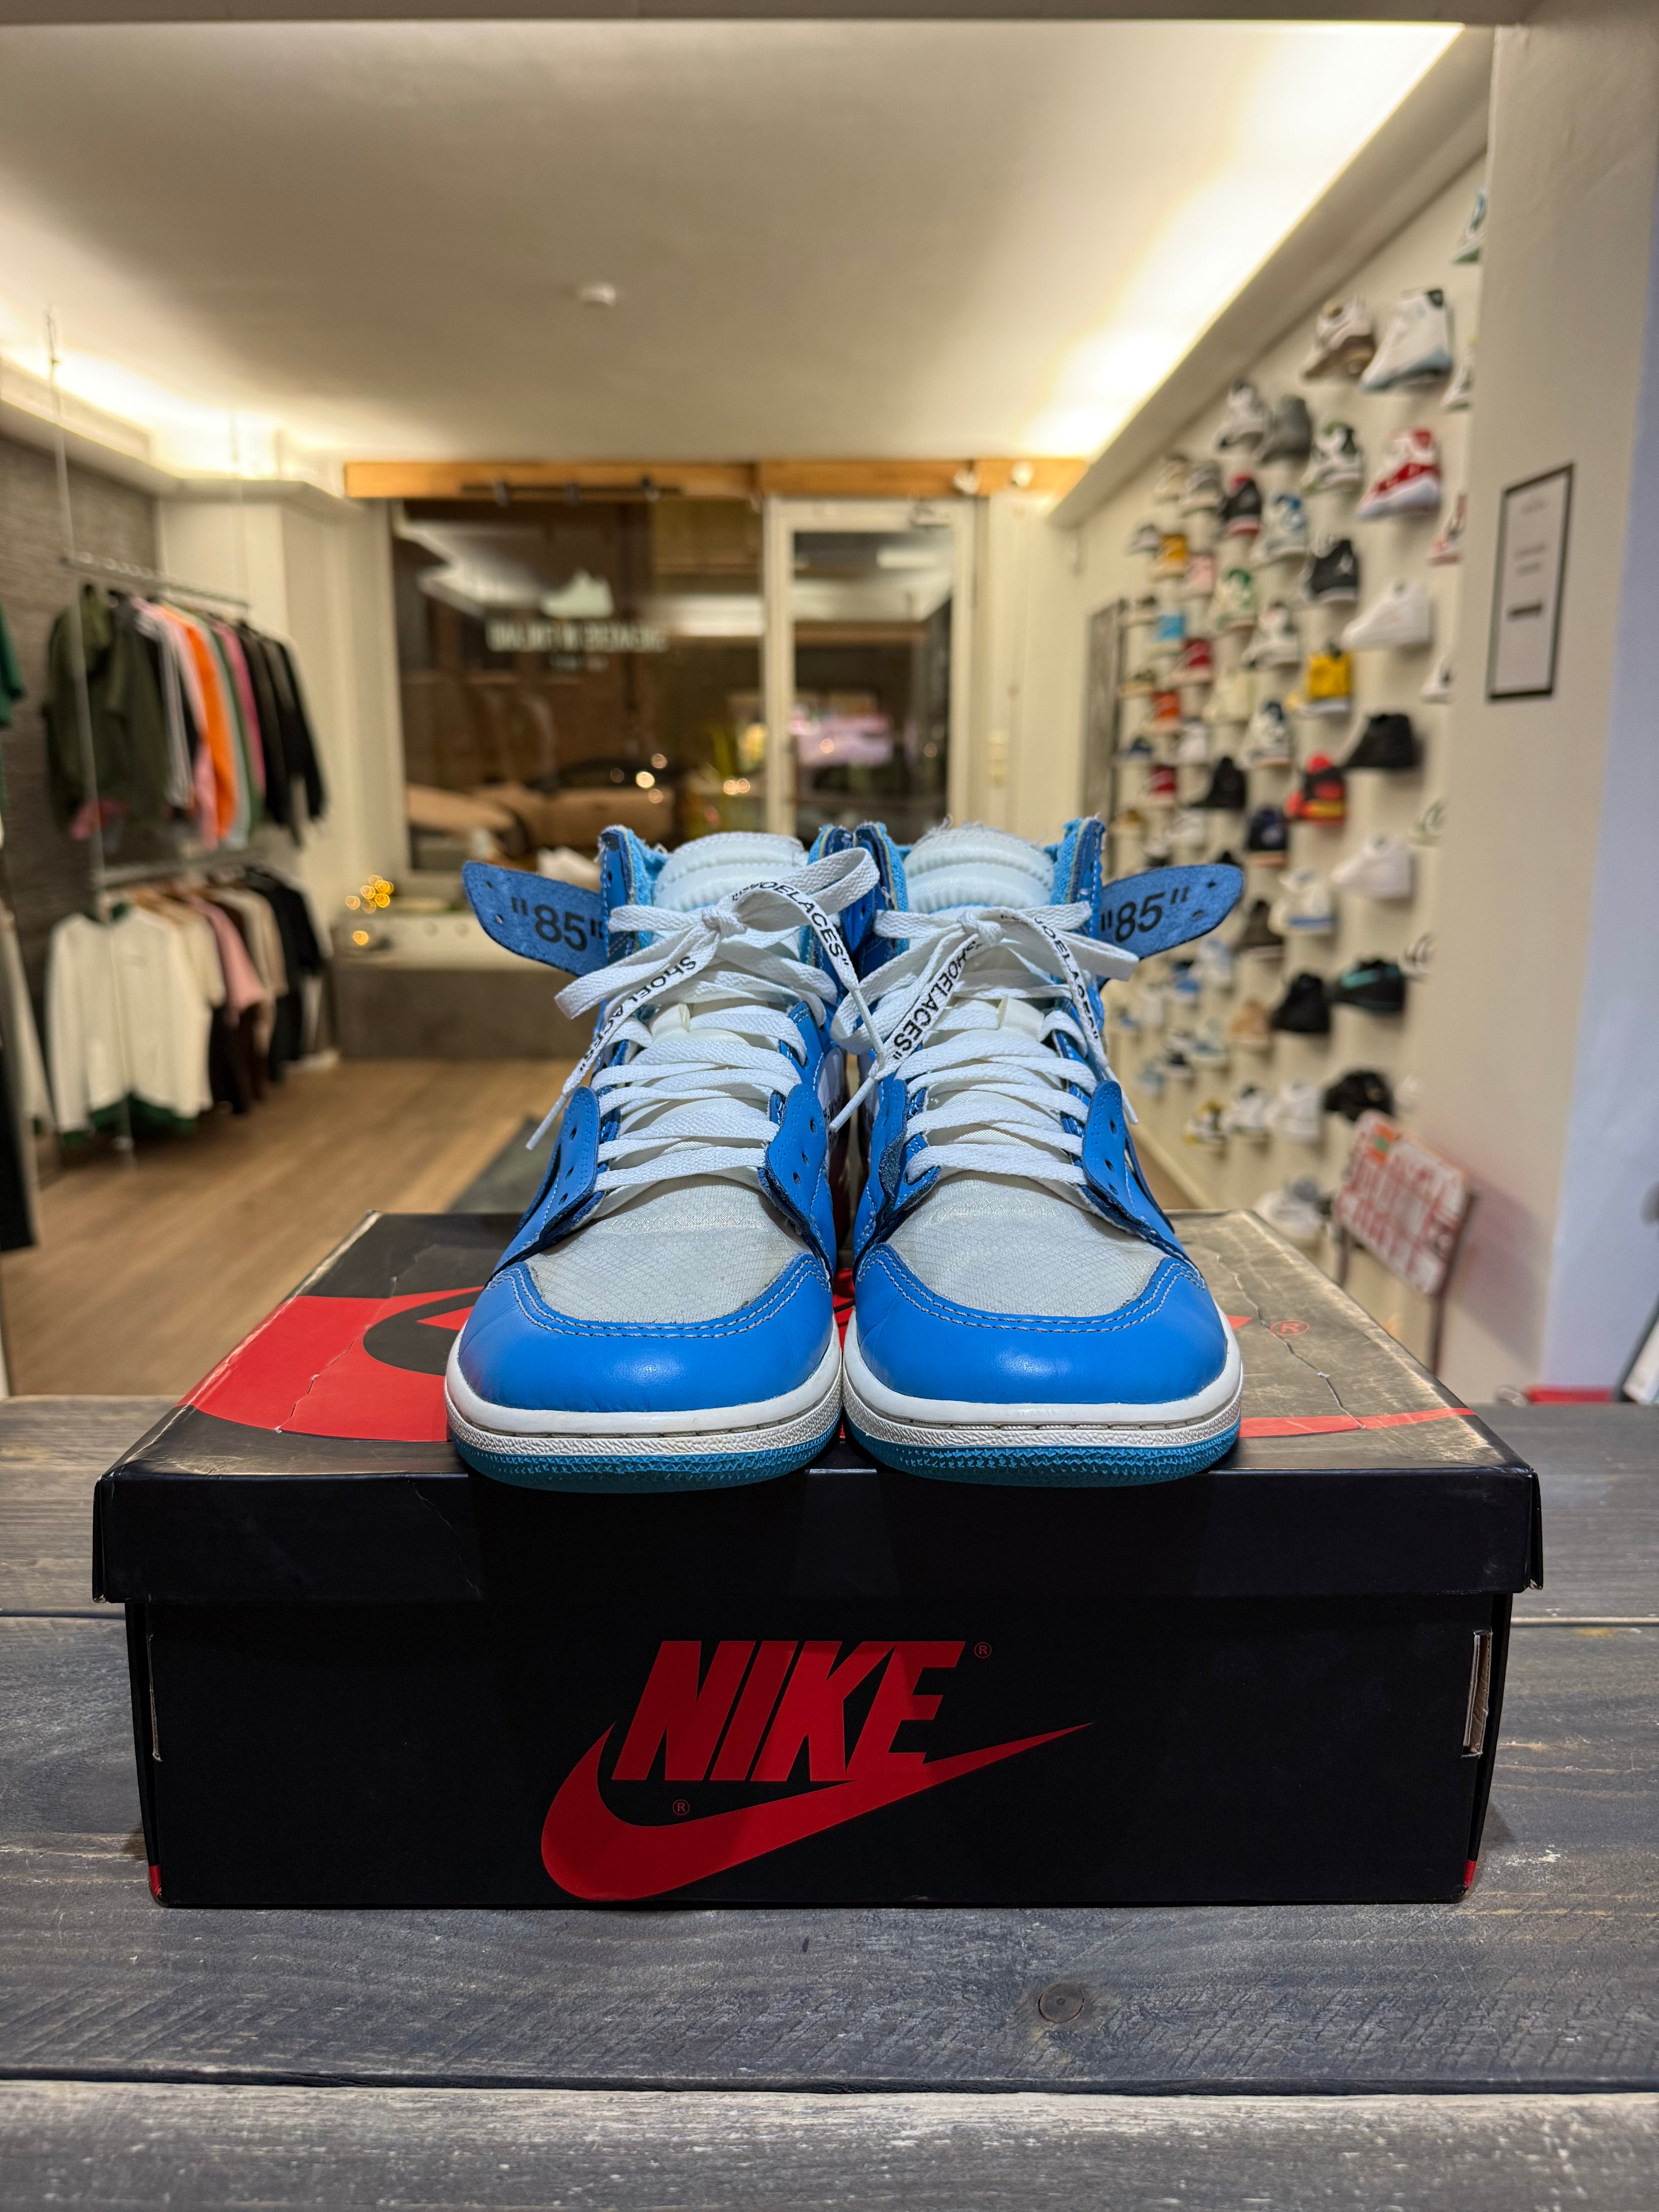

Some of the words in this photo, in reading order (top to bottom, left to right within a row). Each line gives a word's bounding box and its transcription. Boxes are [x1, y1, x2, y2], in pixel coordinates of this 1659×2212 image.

[511, 896, 604, 952] "85"
[1101, 887, 1190, 943] "85"
[611, 1640, 966, 1782] NIKE
